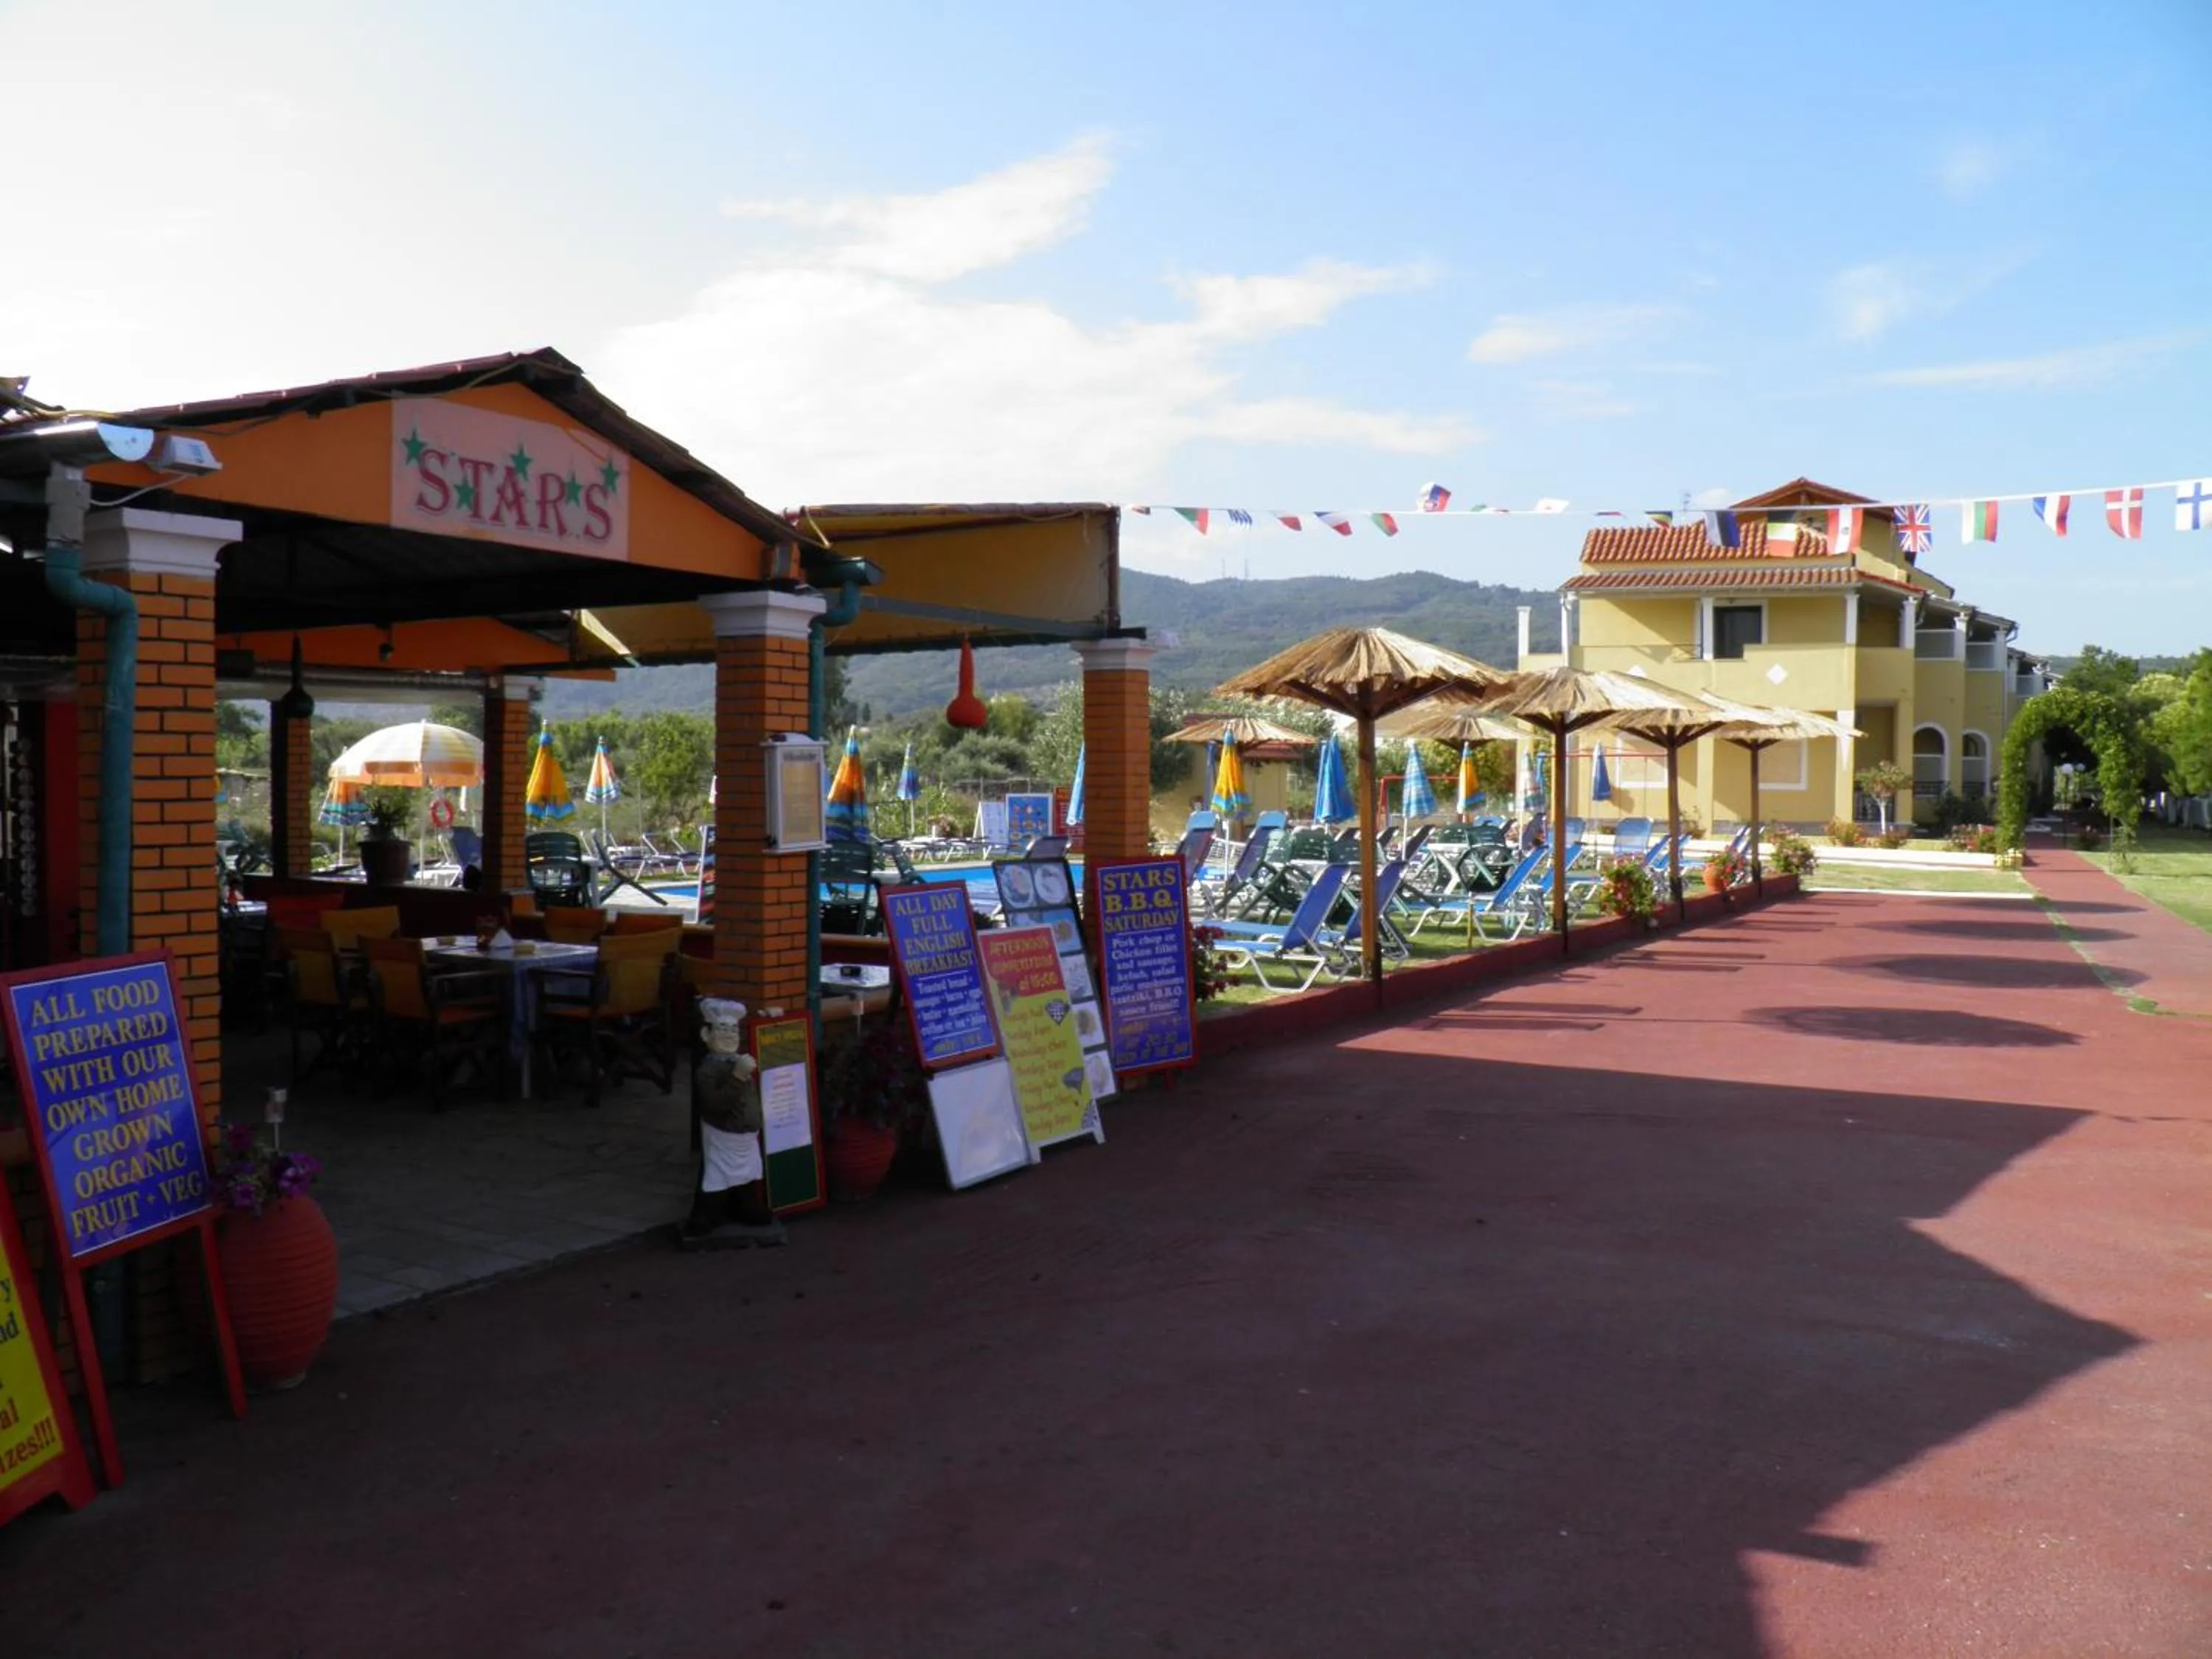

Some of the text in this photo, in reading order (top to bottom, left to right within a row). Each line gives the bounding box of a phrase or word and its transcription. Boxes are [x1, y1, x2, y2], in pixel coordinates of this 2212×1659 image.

[415, 448, 613, 541] STARS
[1104, 867, 1177, 891] STARS
[896, 892, 957, 917] ALL DAY
[911, 914, 953, 934] FULL
[1105, 908, 1179, 933] SATURDAY
[904, 931, 967, 956] ENGLISH
[905, 949, 974, 975] BREAKFAST
[31, 978, 161, 1027] ALL FOOD
[34, 1011, 168, 1062] PREPARED
[42, 1043, 175, 1096] WITH OUR
[46, 1074, 184, 1133] OWN HOME
[73, 1110, 174, 1161] GROWN
[75, 1142, 188, 1199] ORGANIC
[70, 1191, 140, 1239] FRUIT
[158, 1170, 204, 1204] VEG
